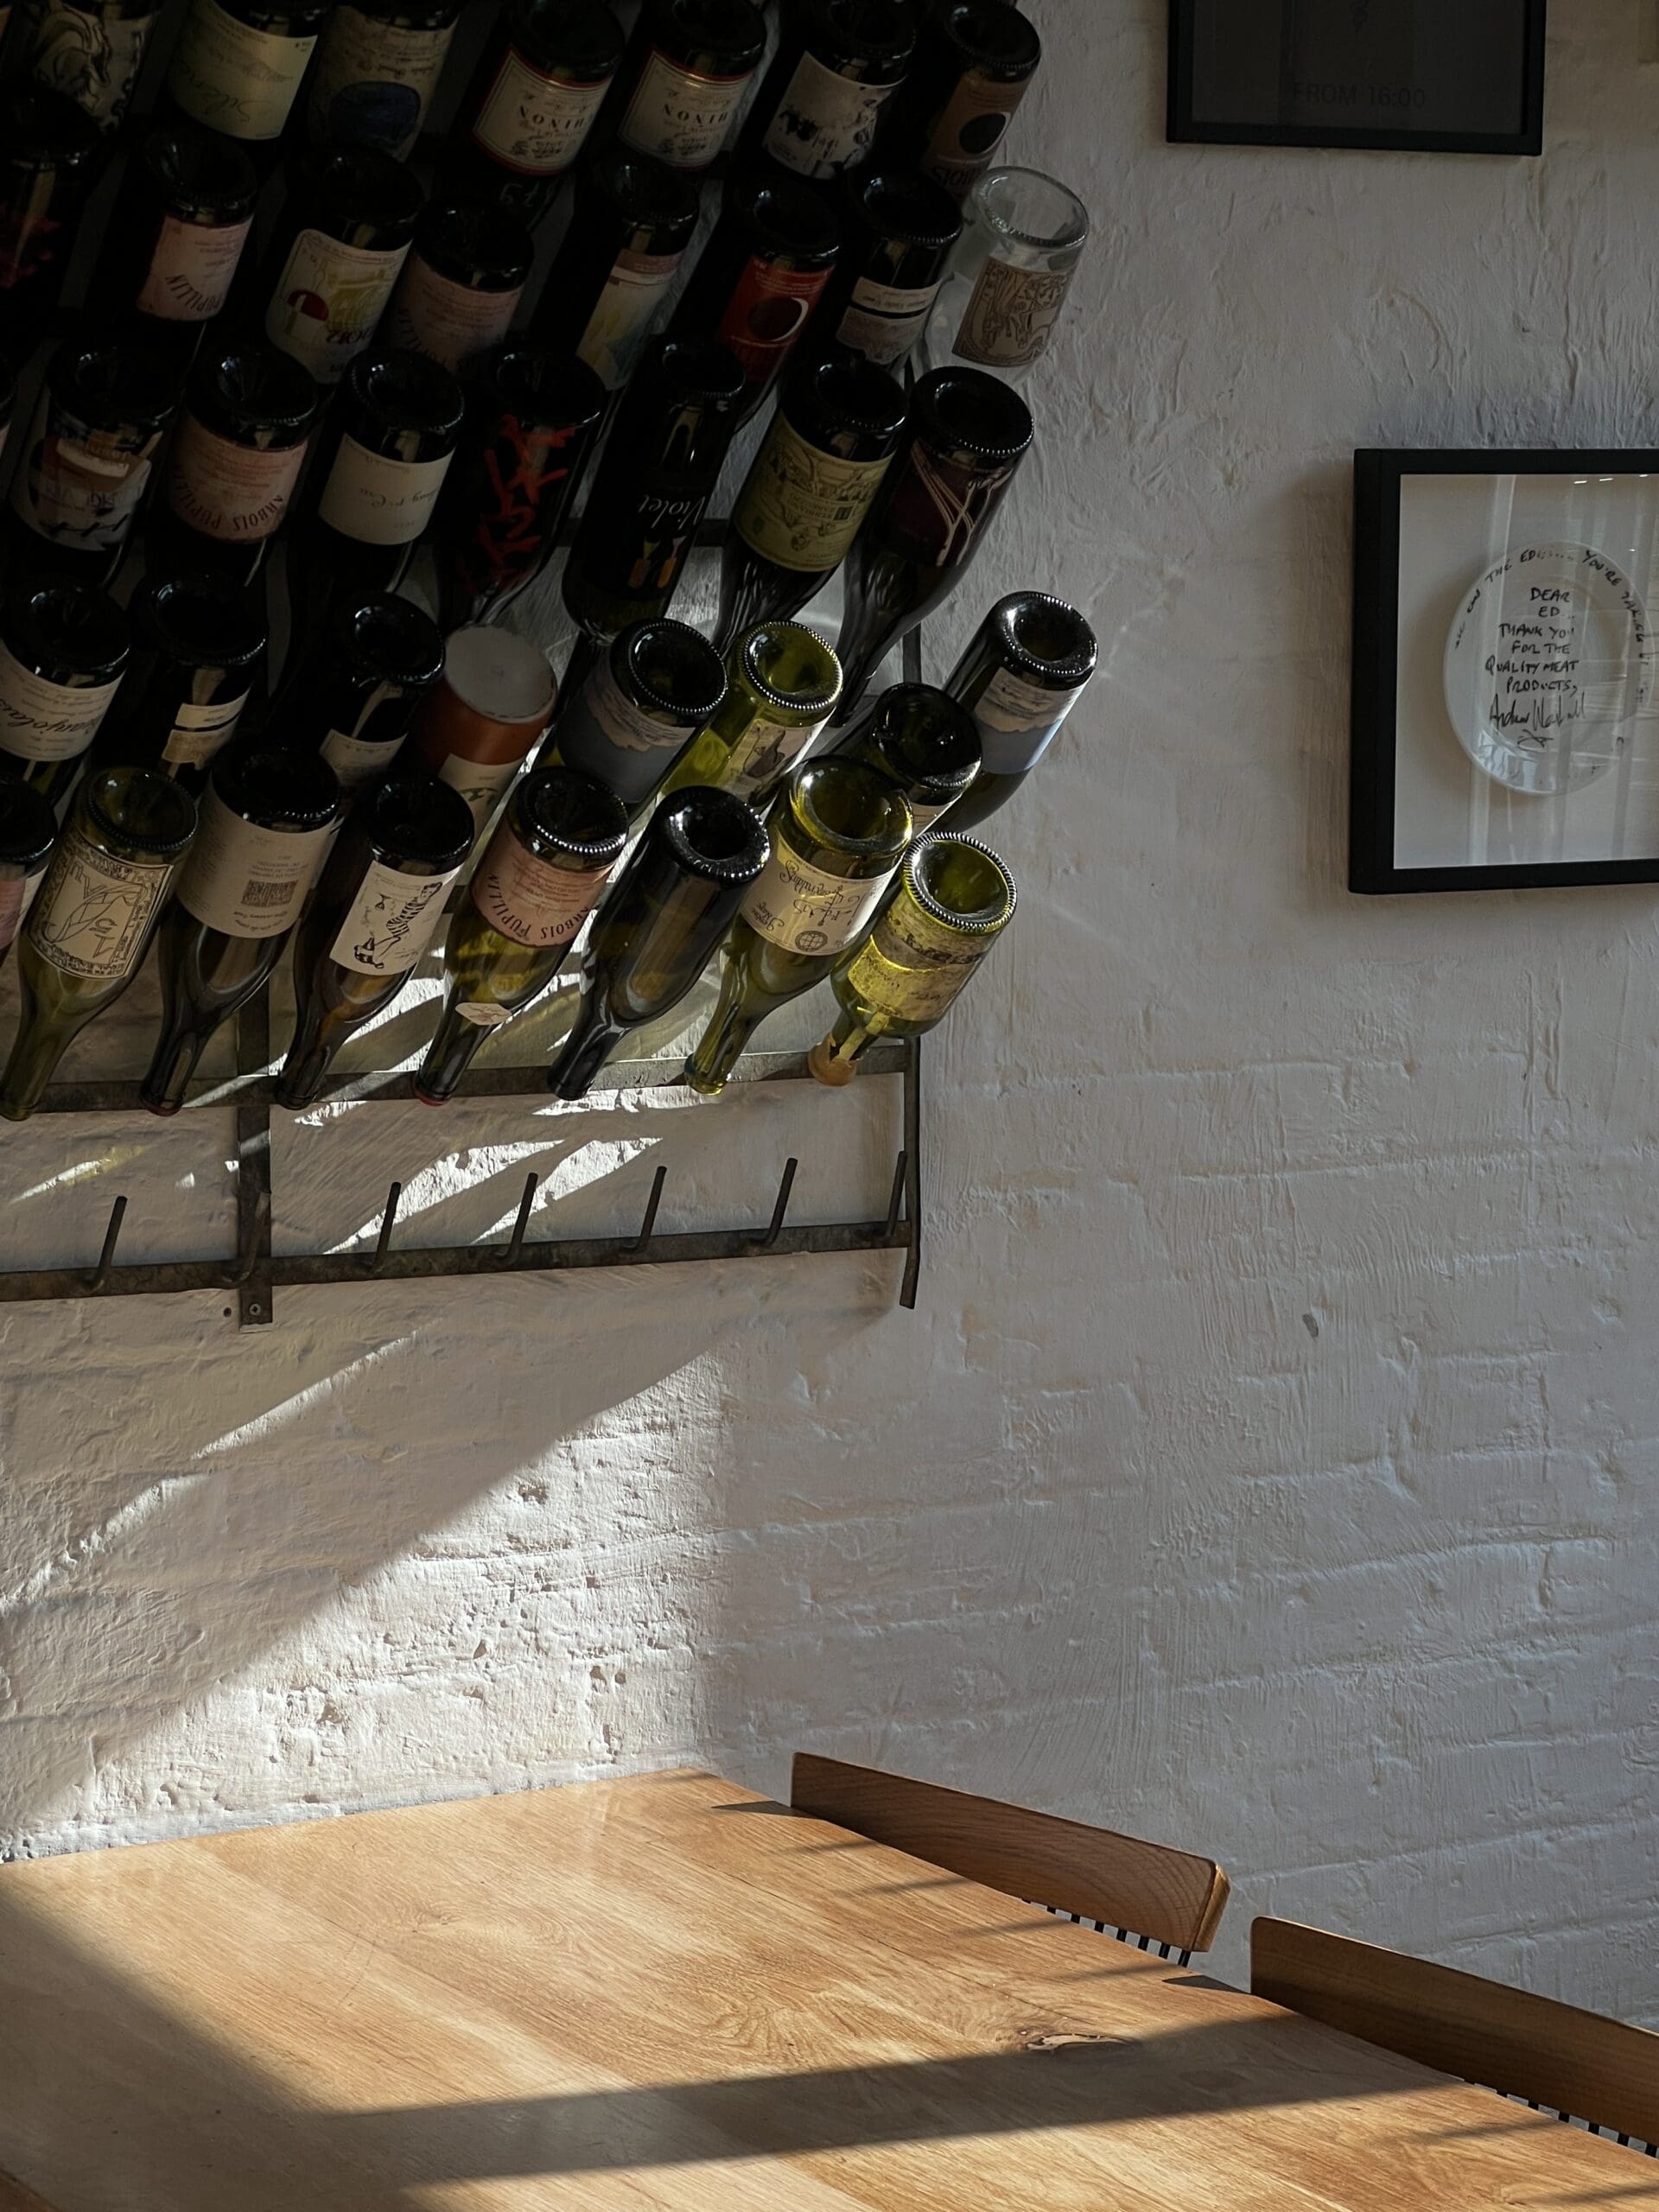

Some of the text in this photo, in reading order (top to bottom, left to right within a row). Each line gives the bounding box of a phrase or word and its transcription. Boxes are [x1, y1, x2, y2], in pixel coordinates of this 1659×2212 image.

[1293, 82, 1425, 108] FROM 16:00
[232, 494, 284, 531] ARBOIS
[636, 493, 706, 531] Violet
[1484, 557, 1512, 583] THE
[1580, 550, 1623, 587] YOU'RE
[1530, 587, 1571, 603] DEAR
[1498, 623, 1542, 639] THANK
[1511, 640, 1572, 654] FOR THE
[1484, 655, 1580, 677] QUALITY MEAT
[486, 873, 531, 940] PUPILLIN
[539, 906, 589, 939] ARBOIS
